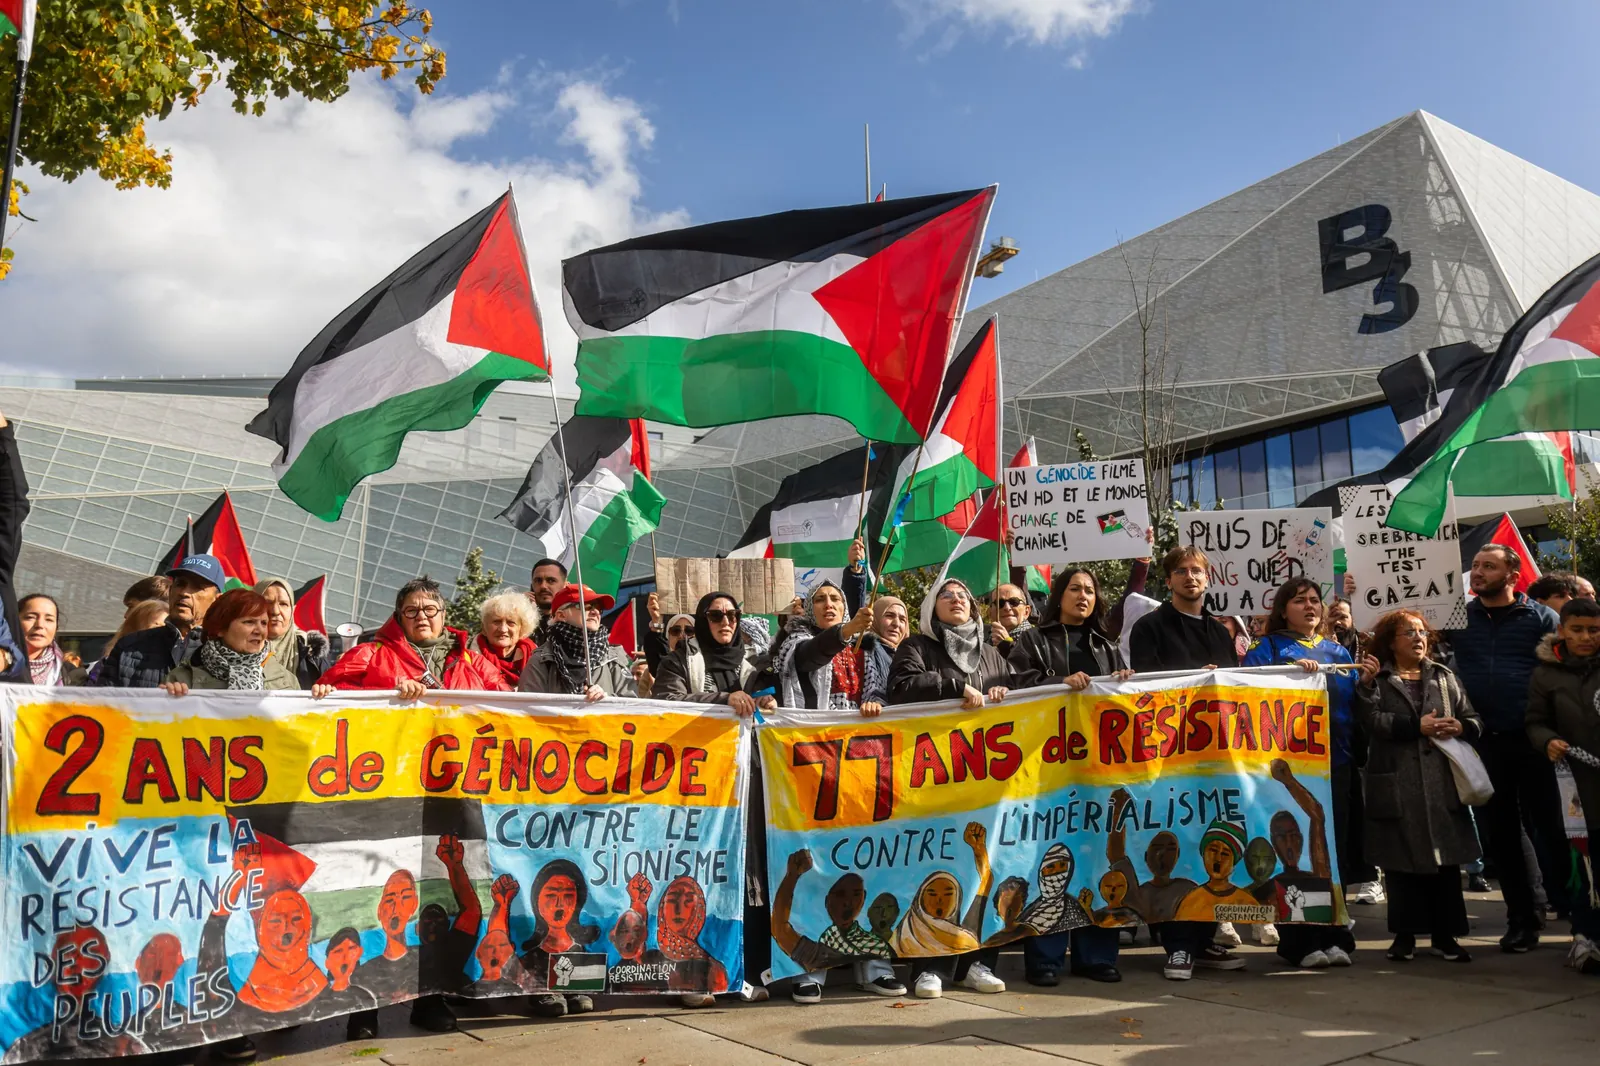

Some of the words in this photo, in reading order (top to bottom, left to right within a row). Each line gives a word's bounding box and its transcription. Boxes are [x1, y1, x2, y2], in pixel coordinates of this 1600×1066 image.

[1009, 470, 1026, 487] UN
[1036, 463, 1097, 484] GÉNOCIDE
[1102, 460, 1137, 480] FILMÉ
[1010, 492, 1027, 508] EN
[1034, 490, 1053, 506] HD
[1063, 488, 1078, 502] ET
[1087, 487, 1100, 501] LE
[1106, 484, 1147, 500] MONDE
[1011, 512, 1058, 529] CHANGE
[1066, 509, 1086, 523] DE
[1190, 517, 1251, 551] PLUS
[1262, 519, 1288, 549] DE
[1358, 524, 1458, 545] SREBREICA
[1377, 558, 1426, 573] TEST
[1385, 547, 1415, 559] THE
[1397, 575, 1410, 585] IS
[36, 714, 104, 816] 2
[122, 735, 268, 804] ANS
[308, 718, 384, 797] de
[420, 722, 708, 796] GÉNOCIDE
[793, 733, 893, 822] 77
[909, 721, 1023, 788] ANS
[1041, 706, 1088, 764] de
[1099, 692, 1326, 765] RÉSISTANCE
[495, 807, 640, 849] CONTRE
[666, 809, 702, 842] LE
[23, 822, 178, 883] VIVE
[206, 818, 257, 864] LA
[590, 843, 728, 887] SIONISME
[831, 827, 956, 871] CONTRE
[21, 869, 264, 941] RÉSISTANCE
[1214, 905, 1273, 914] COORDINATION
[33, 939, 107, 988] DES
[608, 962, 677, 974] COORDINATION
[51, 967, 236, 1044] PEUPLES
